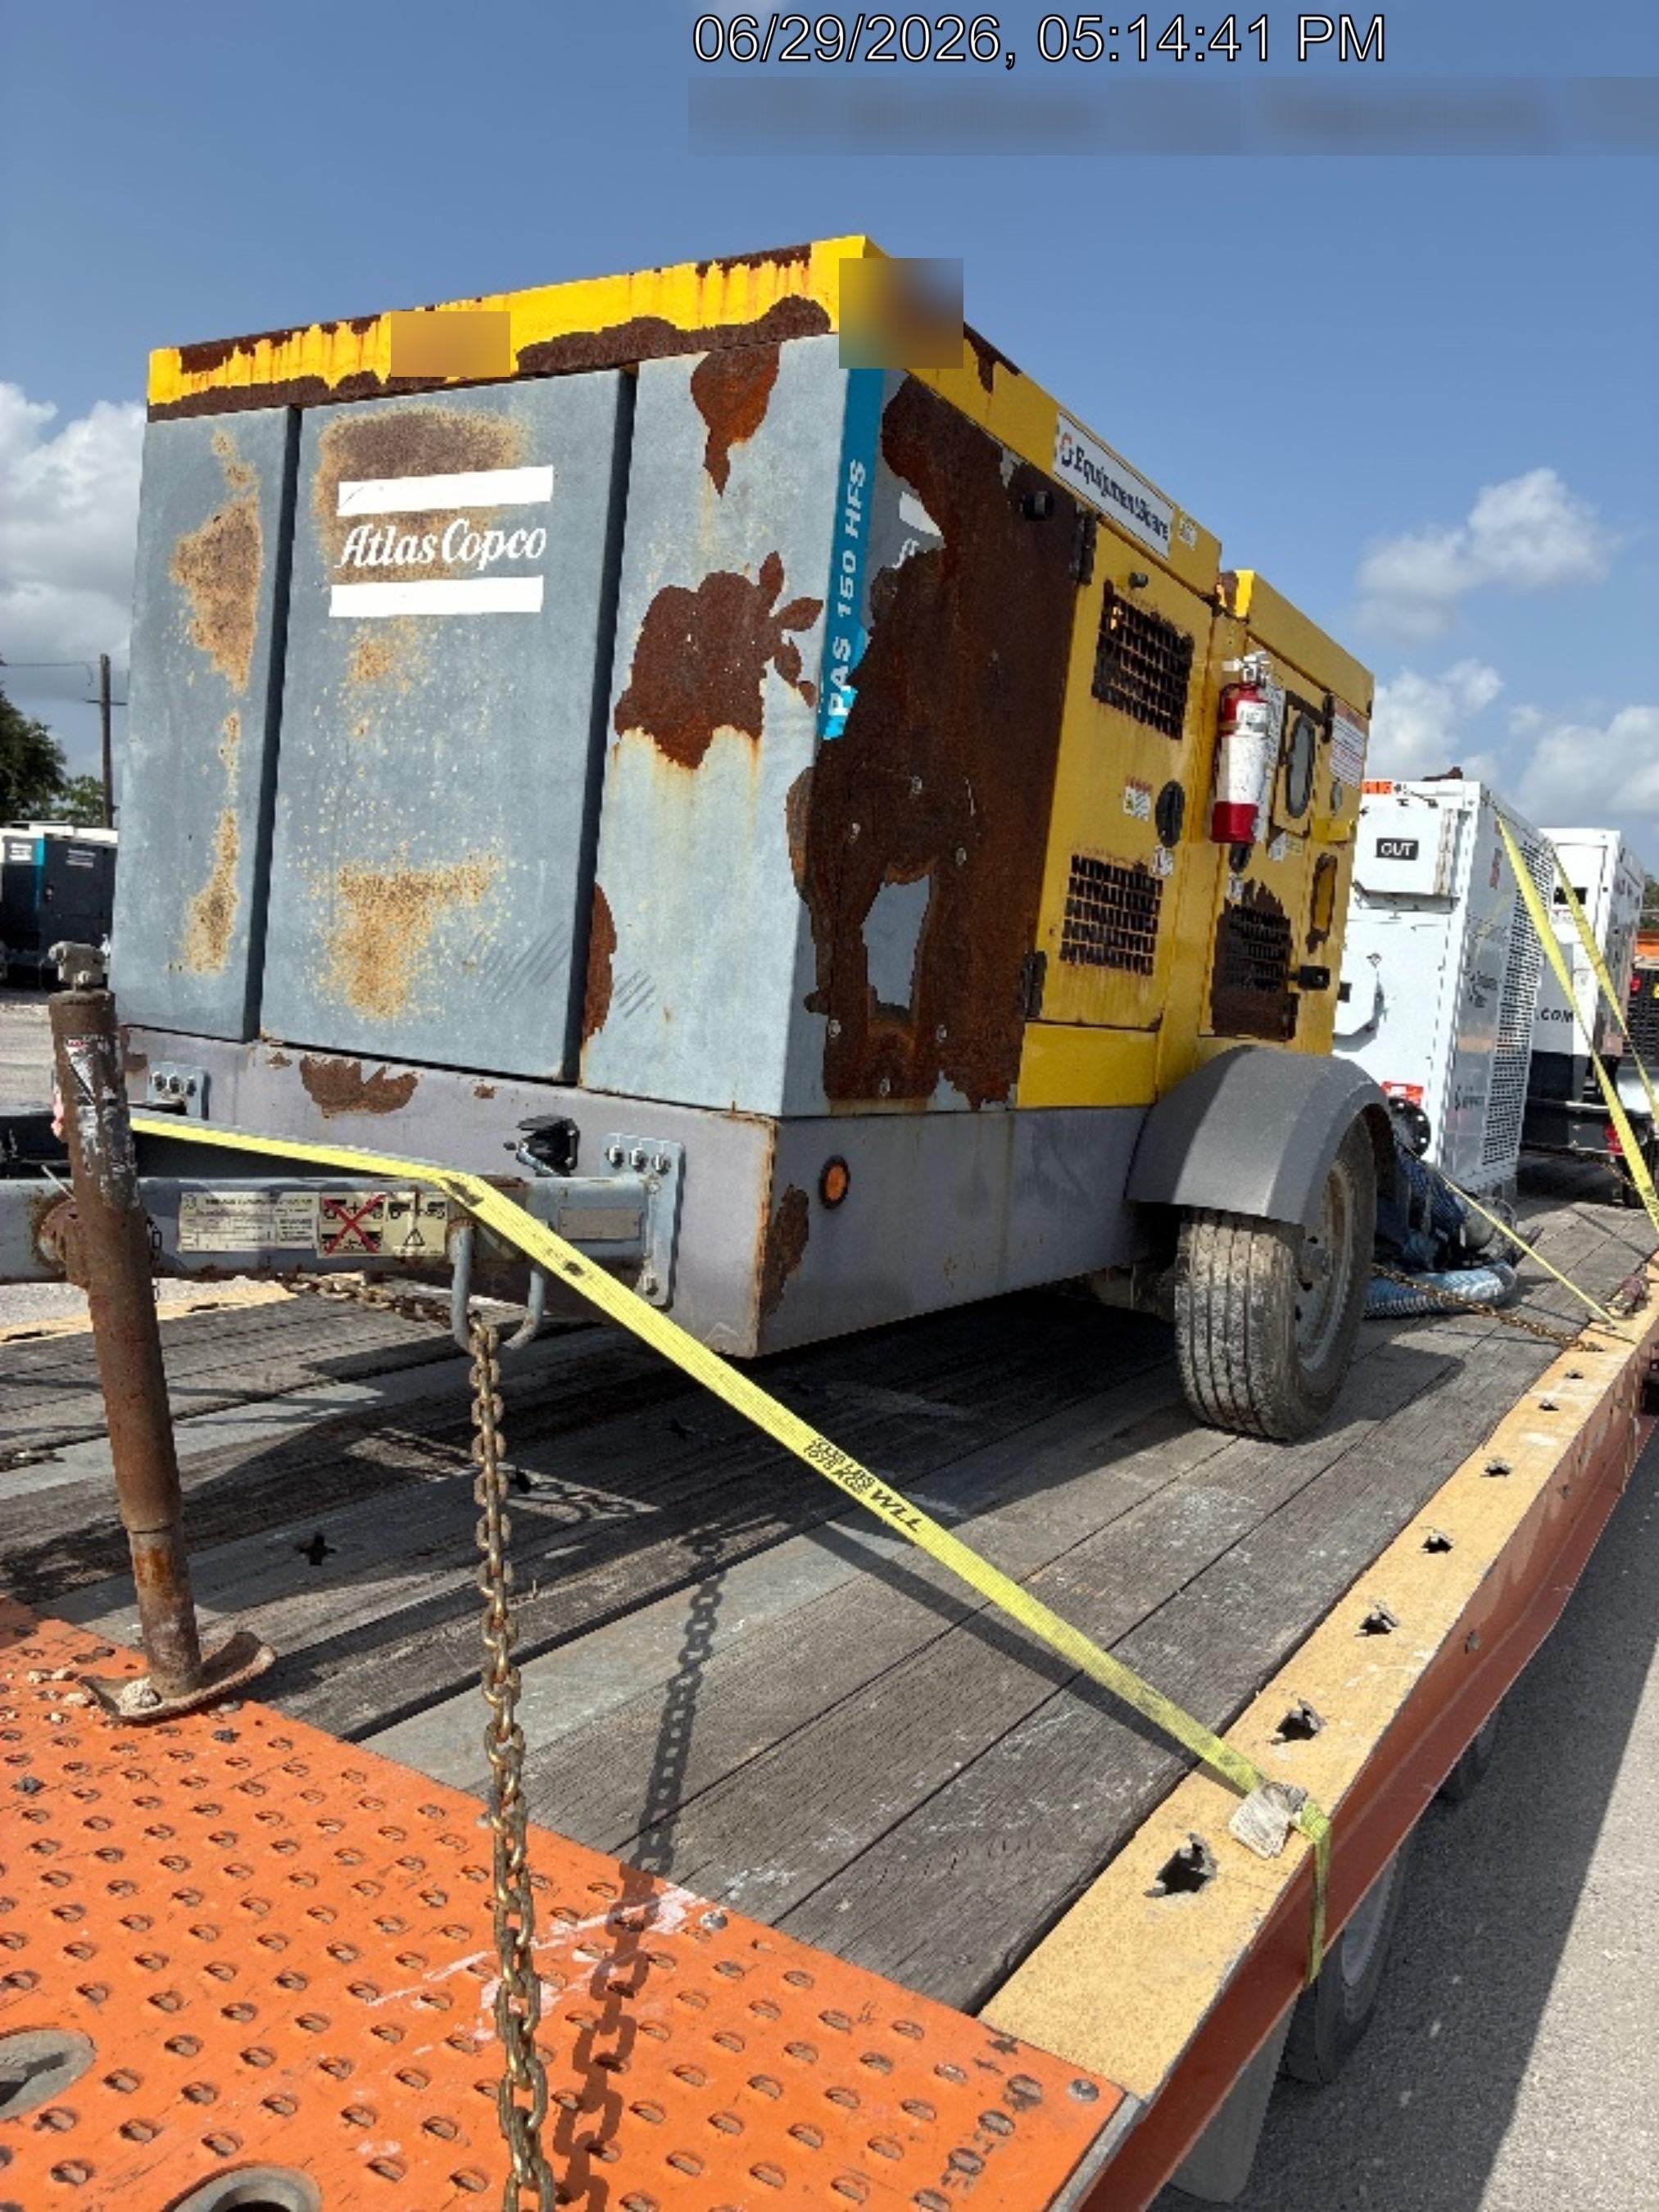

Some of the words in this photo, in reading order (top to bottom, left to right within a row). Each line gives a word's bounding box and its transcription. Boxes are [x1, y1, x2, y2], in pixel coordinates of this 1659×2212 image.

[844, 458, 866, 540] HFS
[333, 523, 438, 569] Atlas
[441, 517, 547, 572] Copco
[836, 550, 856, 618] 150
[827, 636, 852, 716] PAS
[1380, 842, 1415, 857] OUT
